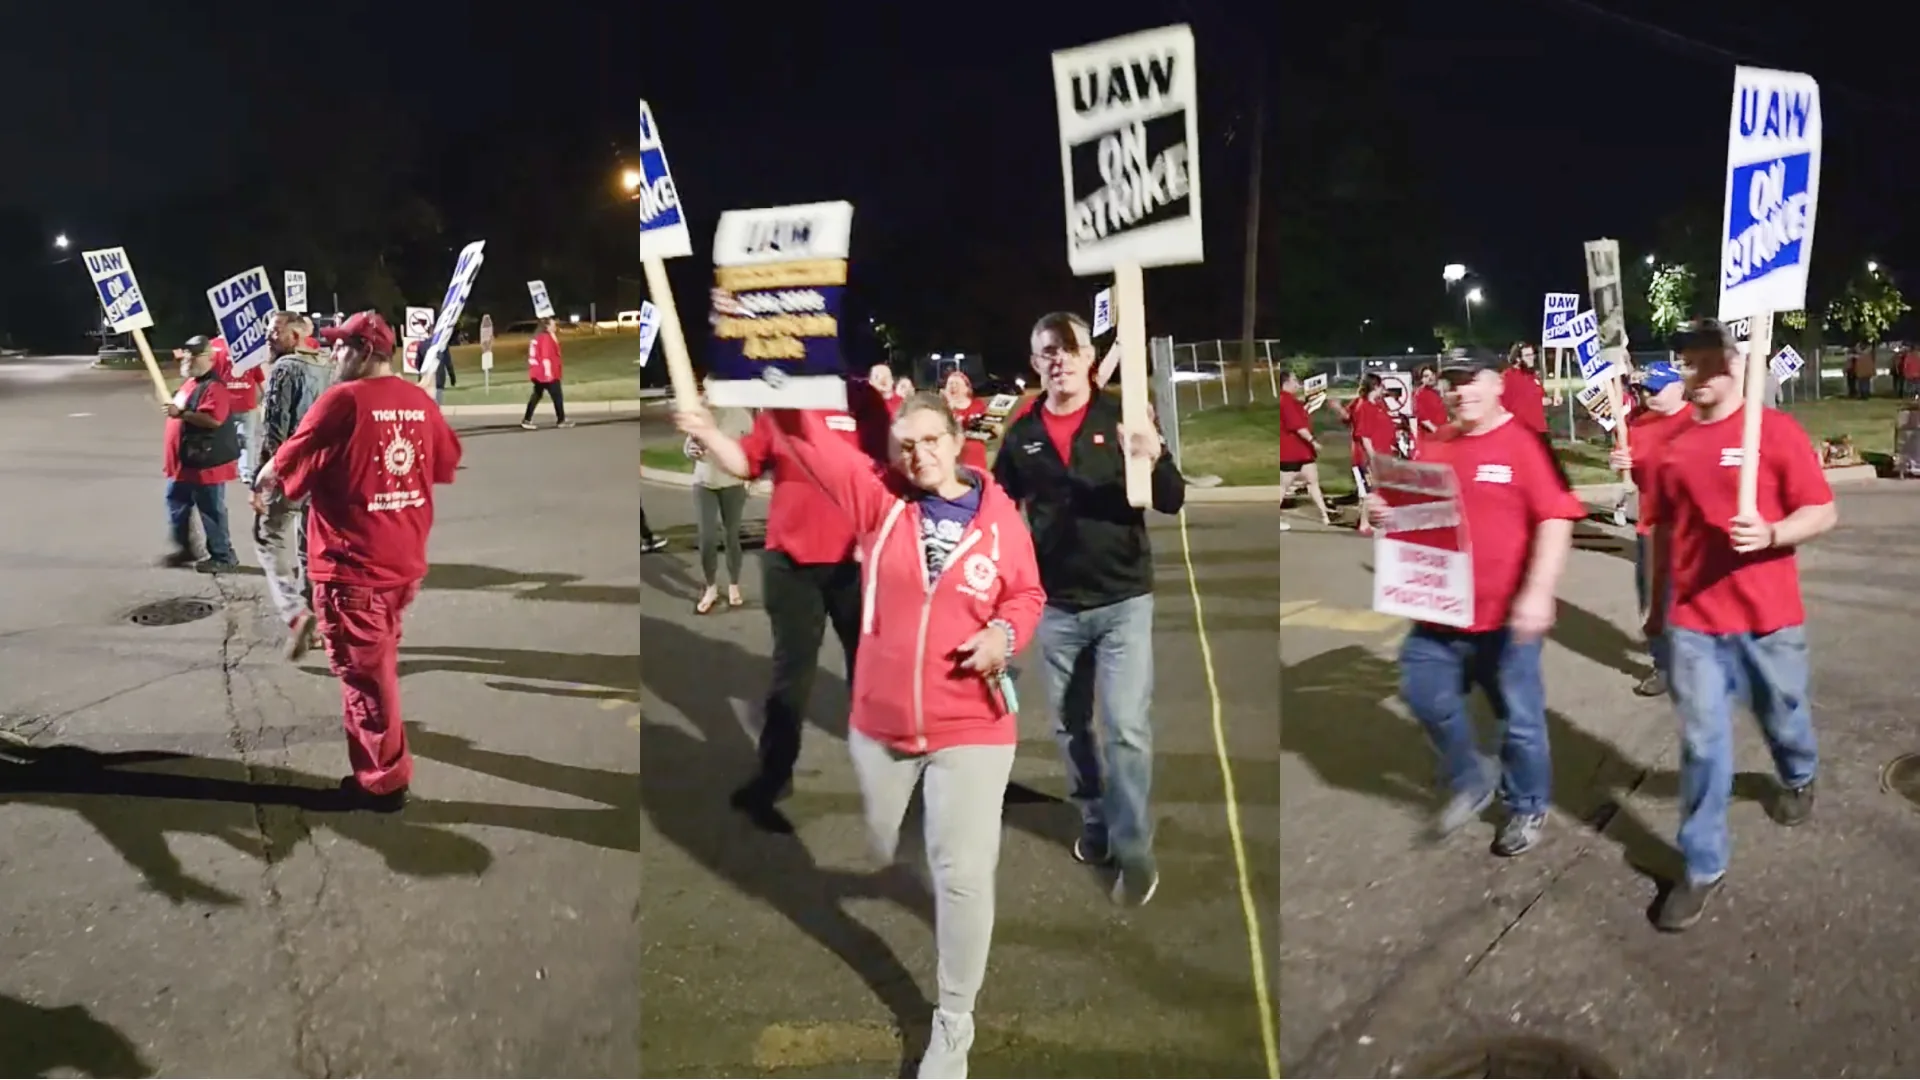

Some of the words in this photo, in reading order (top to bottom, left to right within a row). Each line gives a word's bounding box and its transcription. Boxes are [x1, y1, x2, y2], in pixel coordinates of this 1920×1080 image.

[1071, 56, 1174, 113] UAW
[1740, 87, 1811, 138] UAW
[1098, 119, 1148, 184] ON
[1074, 141, 1189, 248] STRIKE
[1749, 158, 1786, 221] ON
[1725, 191, 1809, 287] STRIKE
[88, 252, 124, 274] UAW
[107, 275, 126, 298] ON
[108, 286, 141, 322] STRIKE
[214, 272, 262, 309] UAW
[1548, 297, 1576, 309] UAW
[235, 301, 258, 331] ON
[1553, 314, 1567, 325] ON
[1584, 385, 1601, 401] UAW
[372, 410, 397, 421] TICK
[398, 410, 425, 422] TOCK
